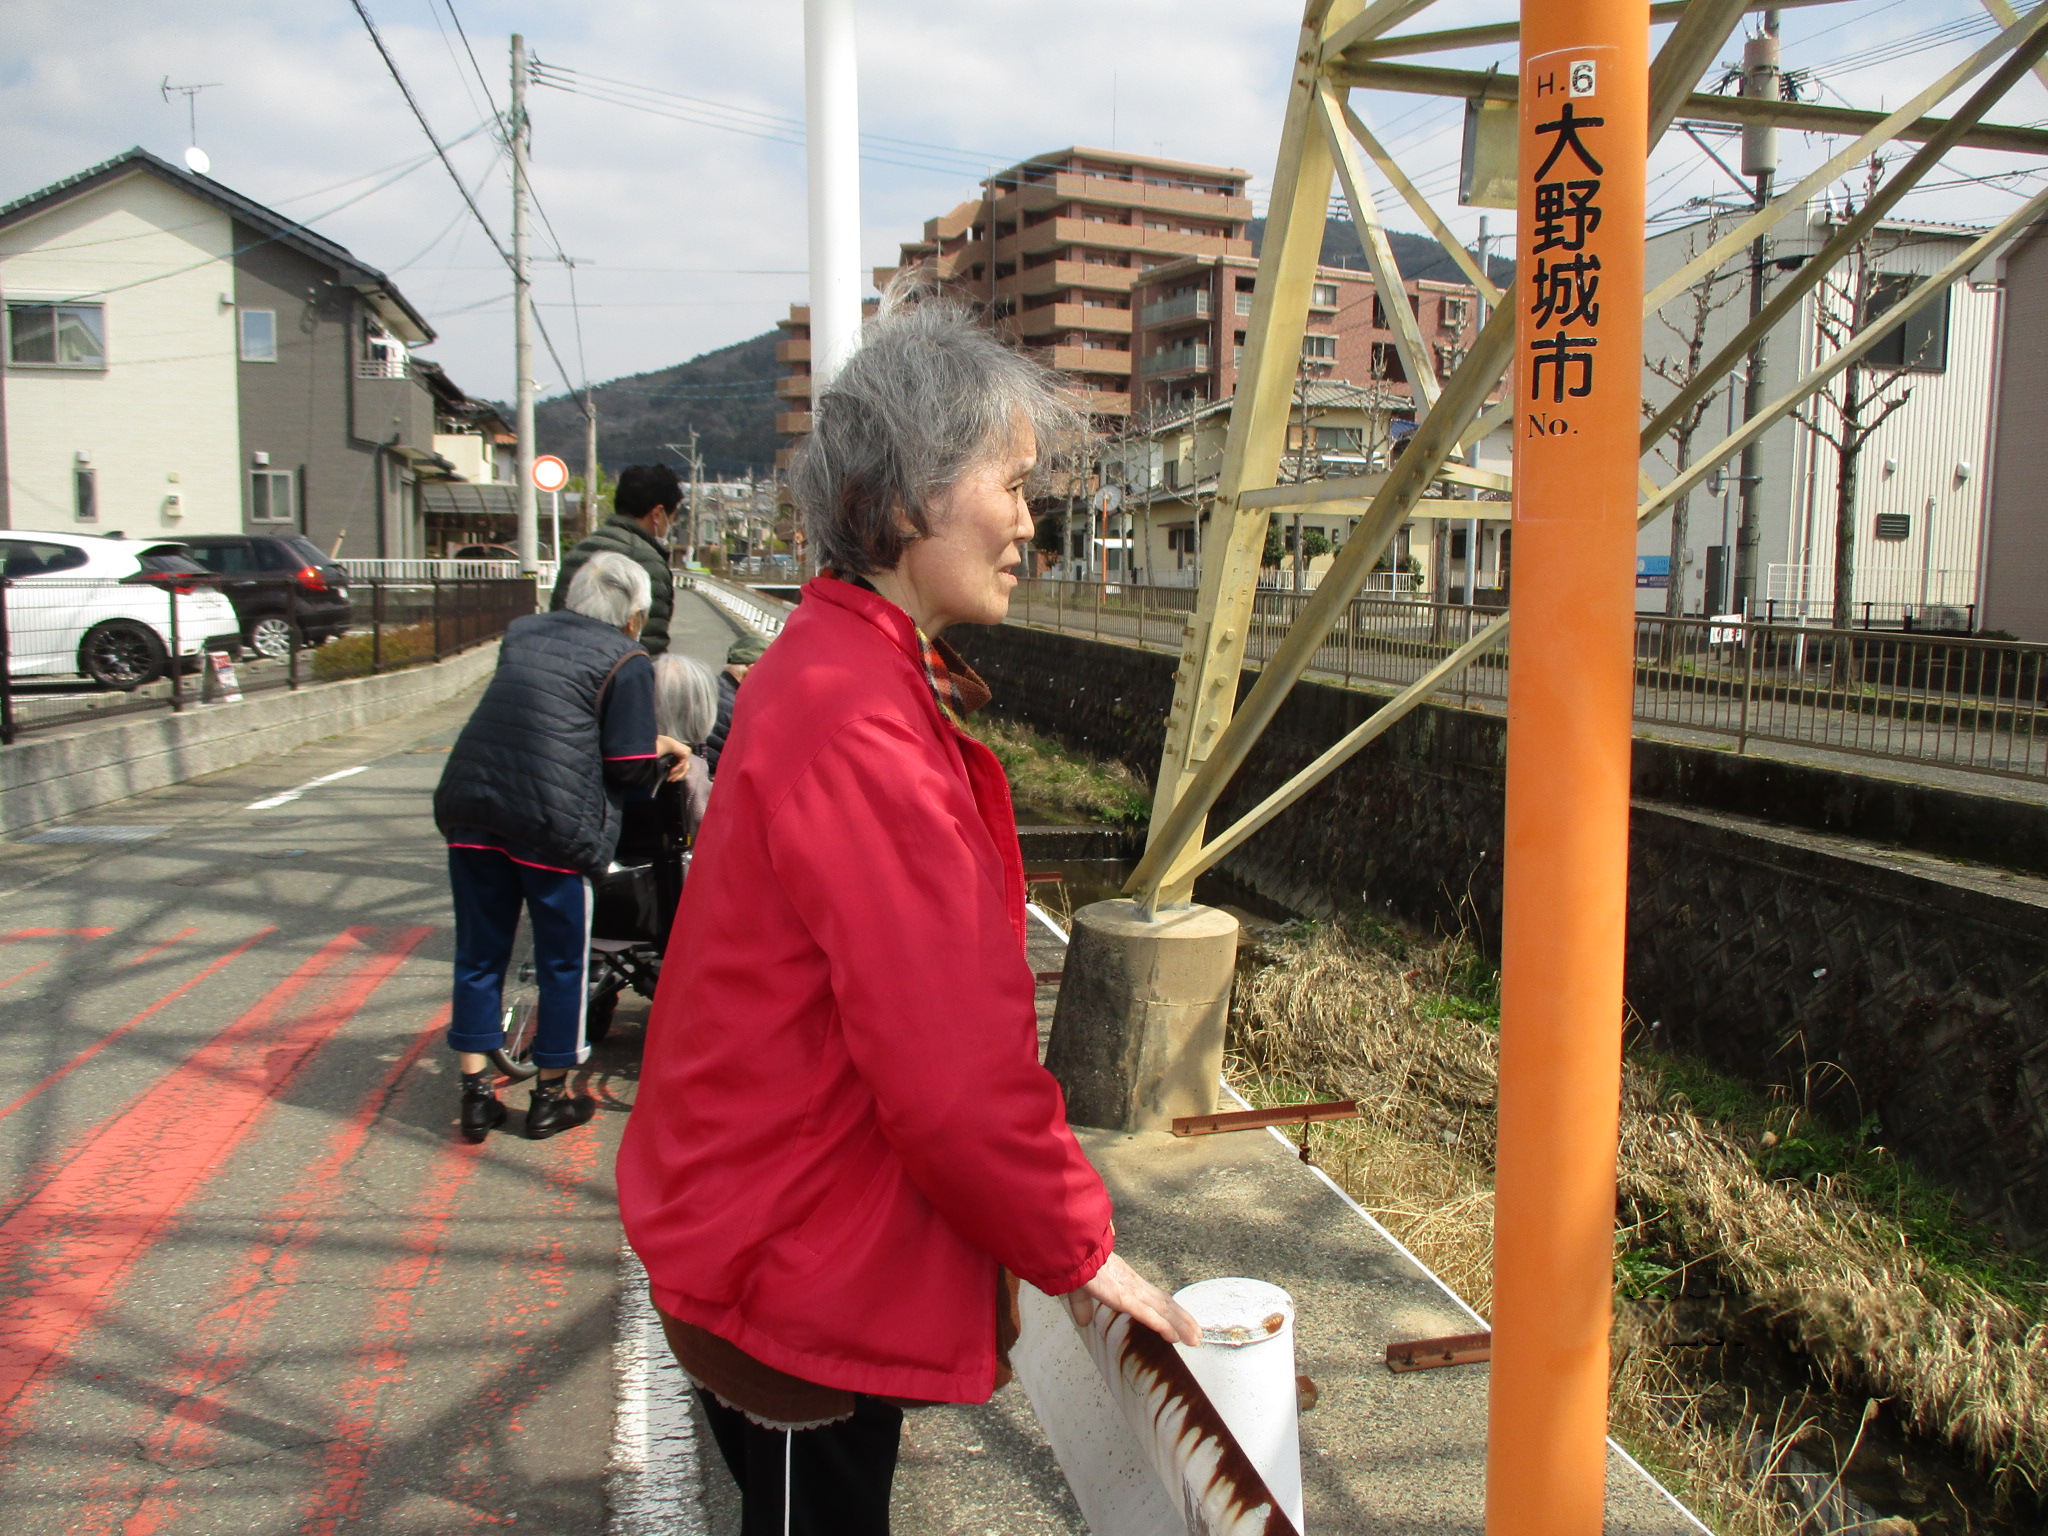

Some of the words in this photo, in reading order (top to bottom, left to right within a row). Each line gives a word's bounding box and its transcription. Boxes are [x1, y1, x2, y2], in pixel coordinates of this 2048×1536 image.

[1531, 102, 1604, 403] 大野城市
[1528, 412, 1578, 438] No.
